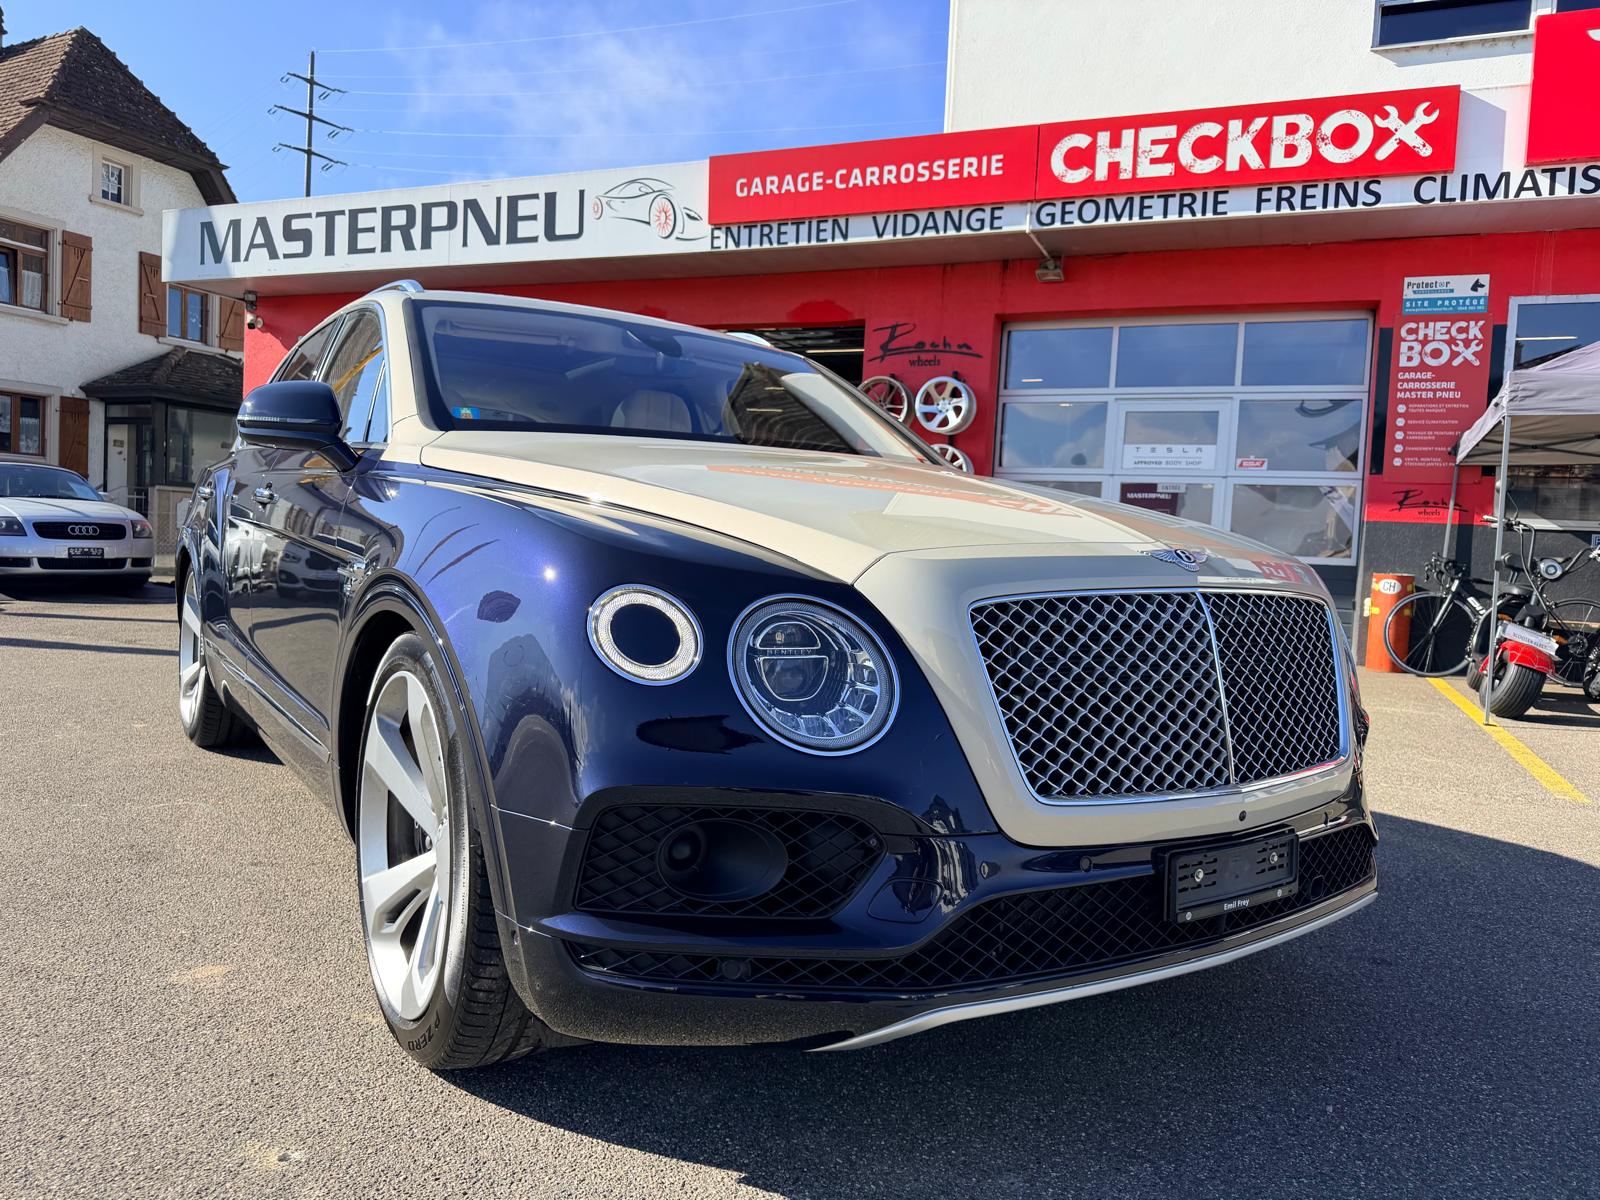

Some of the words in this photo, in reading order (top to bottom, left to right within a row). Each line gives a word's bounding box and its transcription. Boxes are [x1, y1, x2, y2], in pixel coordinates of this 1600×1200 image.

[1050, 101, 1440, 184] CHECKBOX
[735, 153, 1005, 198] GARAGE-CARROSSERIE
[710, 217, 850, 251] ENTRETIEN
[872, 206, 1005, 239] VIDANGE
[1035, 190, 1229, 227] GEOMETRIE
[1255, 179, 1383, 213] FREINS
[200, 188, 586, 266] MASTERPNEU
[1405, 300, 1429, 308] SITE
[1400, 320, 1486, 341] CHECK
[1399, 340, 1483, 368] BOX
[908, 355, 941, 367] wheels
[1398, 371, 1436, 380] GARAGE-
[1397, 381, 1456, 390] CARROSSERIE
[1396, 391, 1434, 399] MASTER
[1436, 390, 1461, 399] PNEU
[1382, 581, 1396, 592] CH
[1224, 900, 1237, 910] Emil
[1238, 899, 1249, 907] Frey
